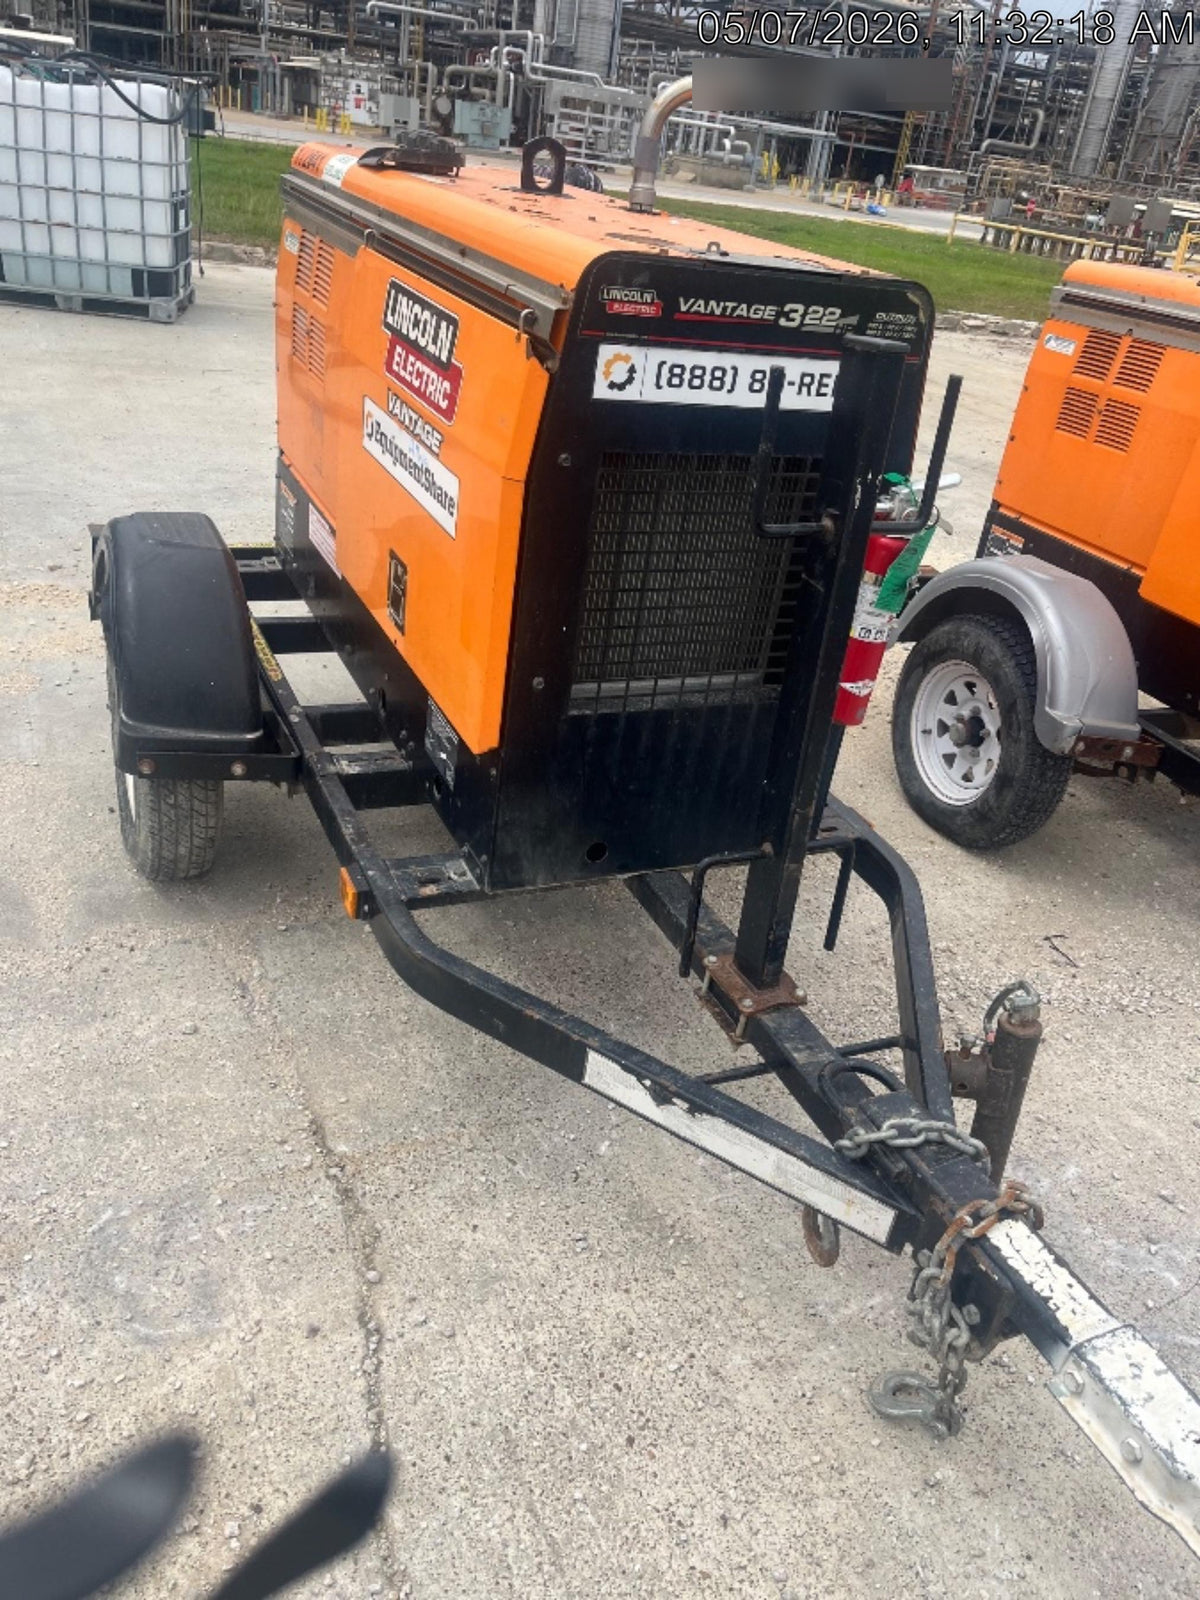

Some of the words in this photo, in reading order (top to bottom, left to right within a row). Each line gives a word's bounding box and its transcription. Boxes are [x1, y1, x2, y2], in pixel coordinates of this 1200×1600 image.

[386, 288, 455, 365] LINCOLN
[602, 287, 654, 303] LINCOLN
[679, 296, 779, 322] VANTAGE
[778, 302, 842, 329] 322
[391, 346, 453, 410] ELECTRIC
[653, 360, 738, 394] (888)
[748, 368, 838, 397] 8-RE
[387, 390, 445, 457] VANTAGE
[374, 419, 456, 519] EquipmentShare
